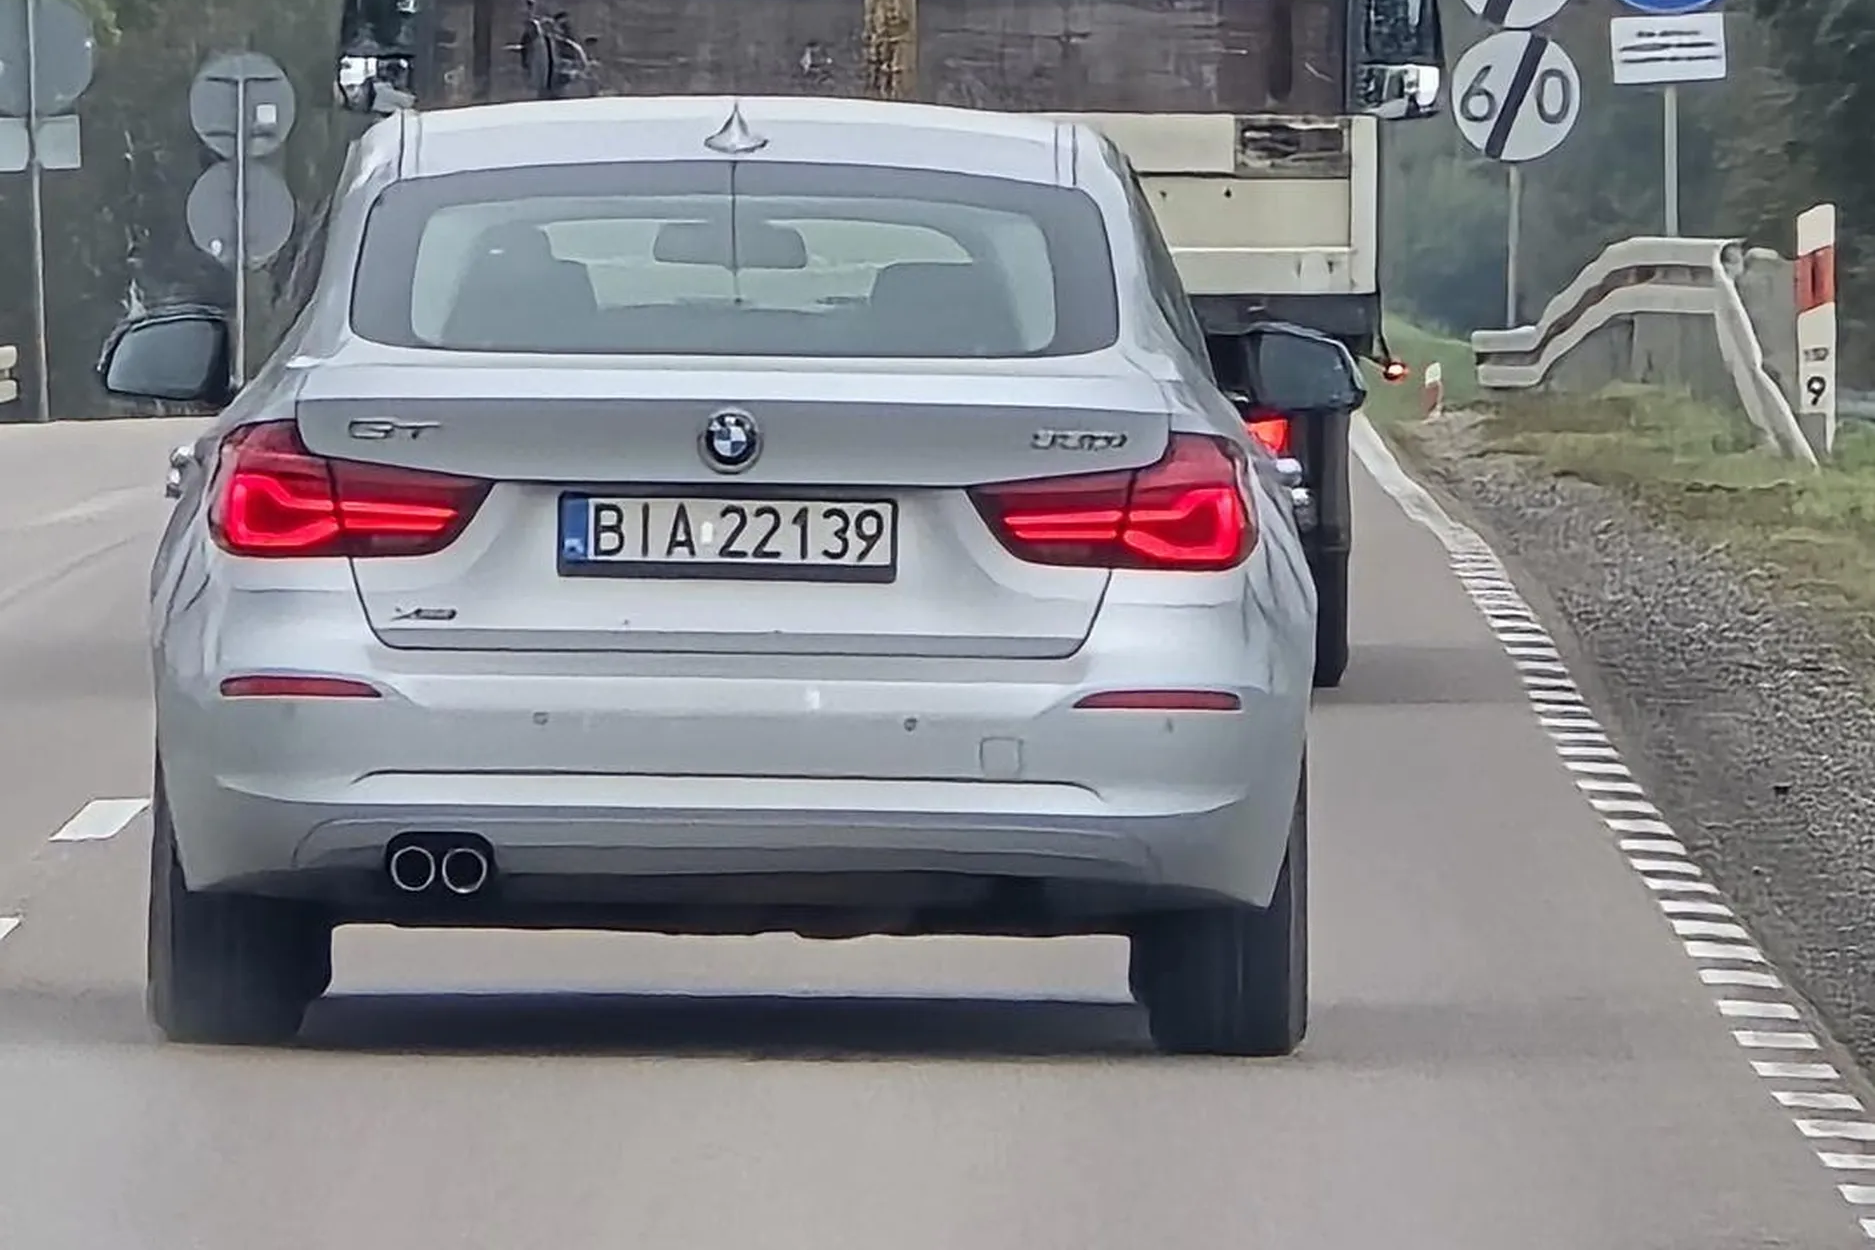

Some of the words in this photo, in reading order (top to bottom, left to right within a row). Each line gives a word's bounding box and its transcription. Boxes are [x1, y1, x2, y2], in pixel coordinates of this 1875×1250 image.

[1460, 64, 1571, 125] 60
[1807, 376, 1826, 406] 9
[593, 502, 696, 558] BIA
[718, 505, 885, 562] 22139
